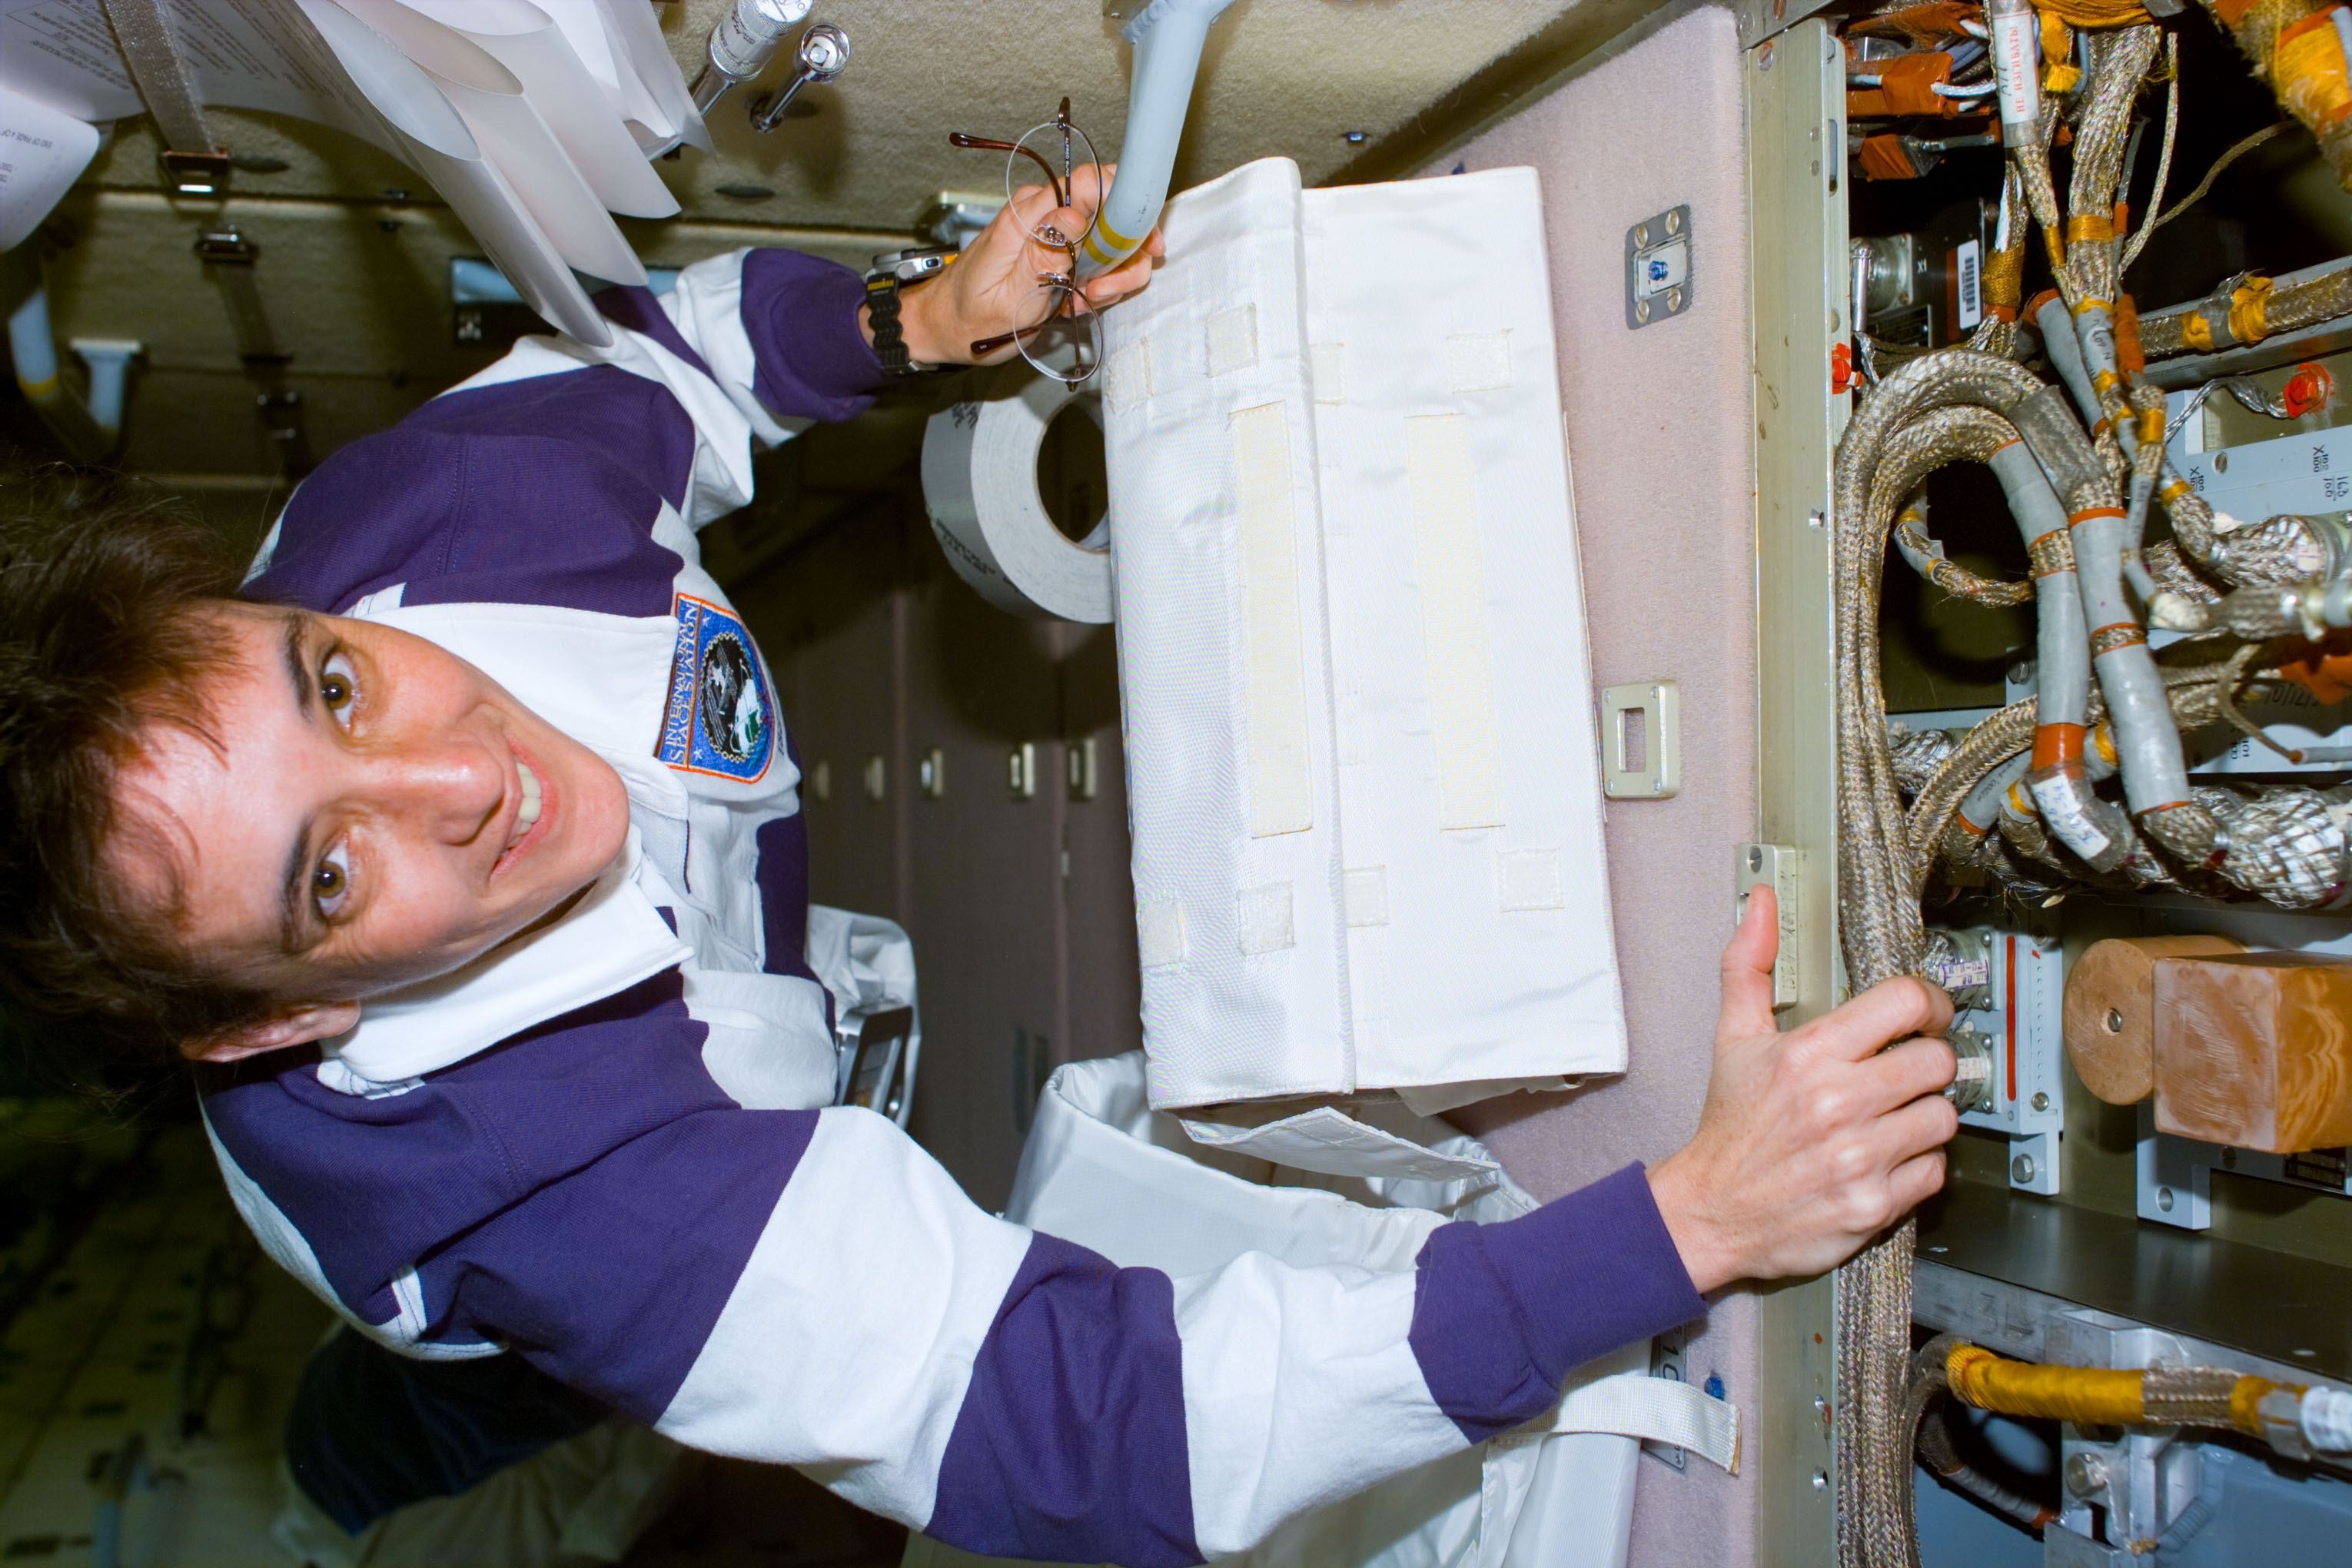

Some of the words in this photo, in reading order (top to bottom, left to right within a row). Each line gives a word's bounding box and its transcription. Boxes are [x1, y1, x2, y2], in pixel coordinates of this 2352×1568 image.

[2015, 97, 2025, 113] НЕ
[666, 623, 687, 746] INTERNATIONAL
[669, 697, 691, 764] SPACE
[683, 603, 700, 693] STATION
